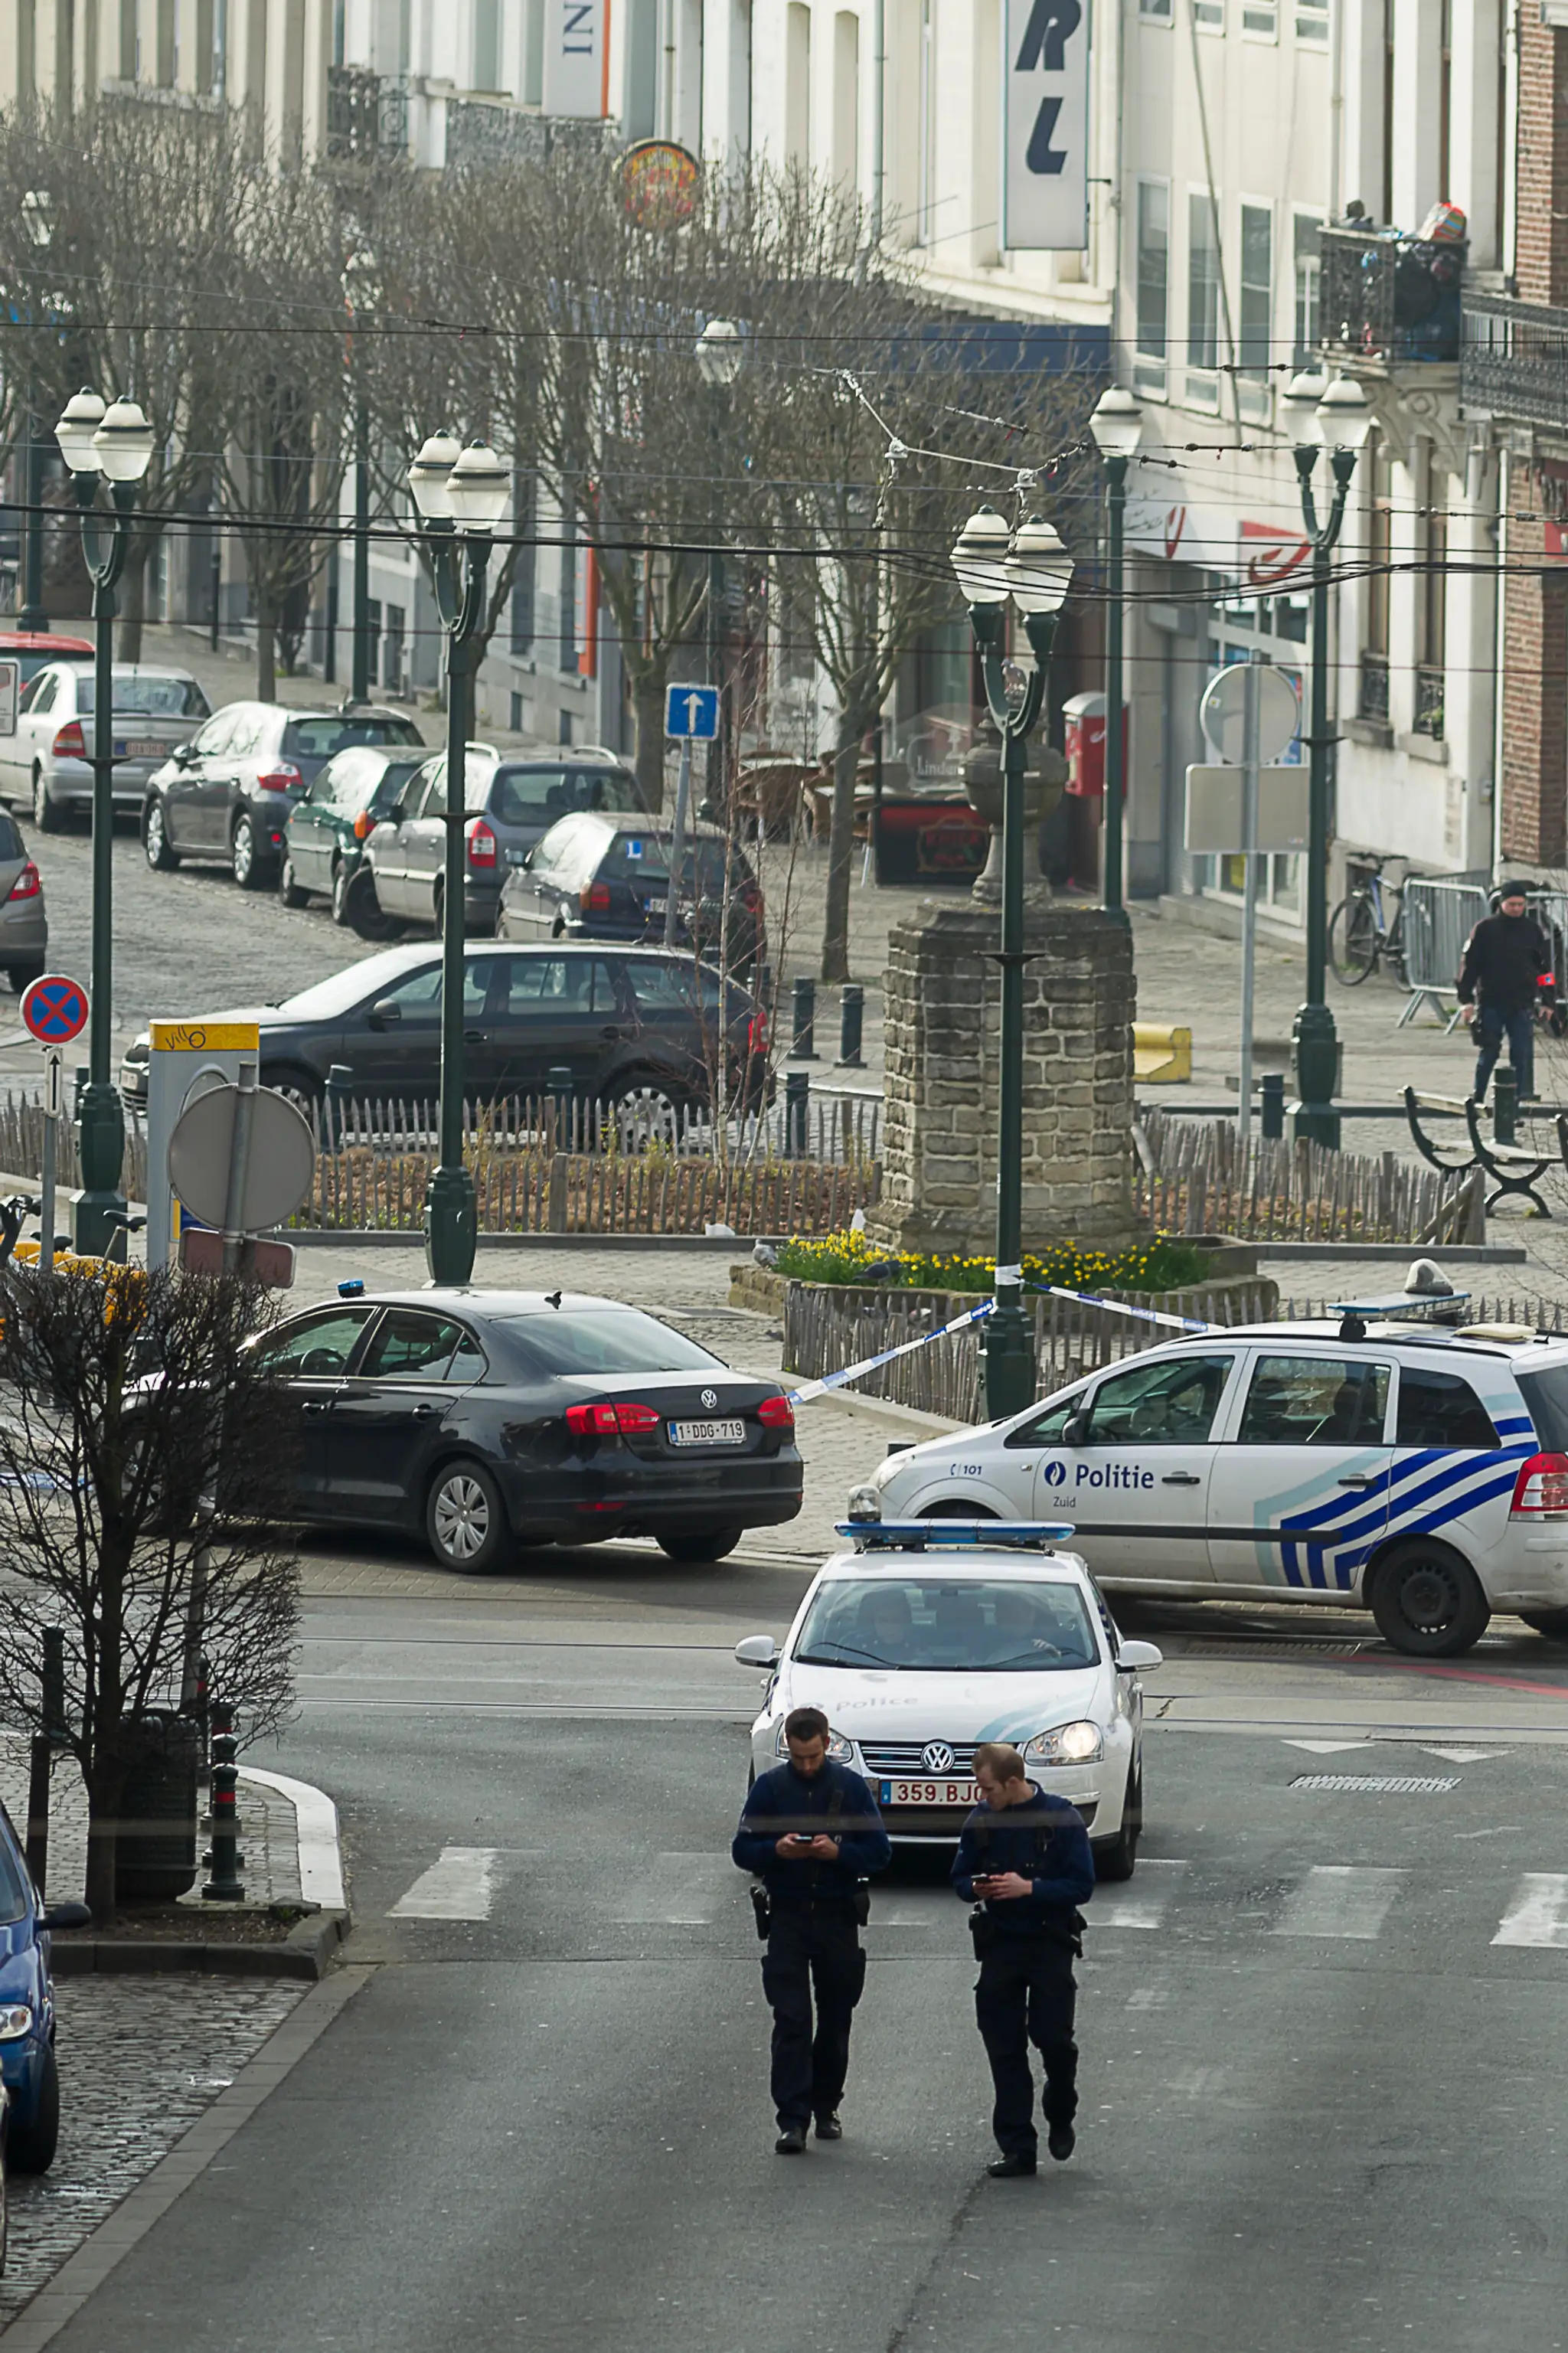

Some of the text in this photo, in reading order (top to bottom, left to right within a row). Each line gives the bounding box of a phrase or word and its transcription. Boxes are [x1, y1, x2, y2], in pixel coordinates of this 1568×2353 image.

[627, 842, 642, 859] L
[964, 1465, 982, 1475] 101
[1076, 1463, 1154, 1489] Politie
[1053, 1496, 1076, 1508] Zuid
